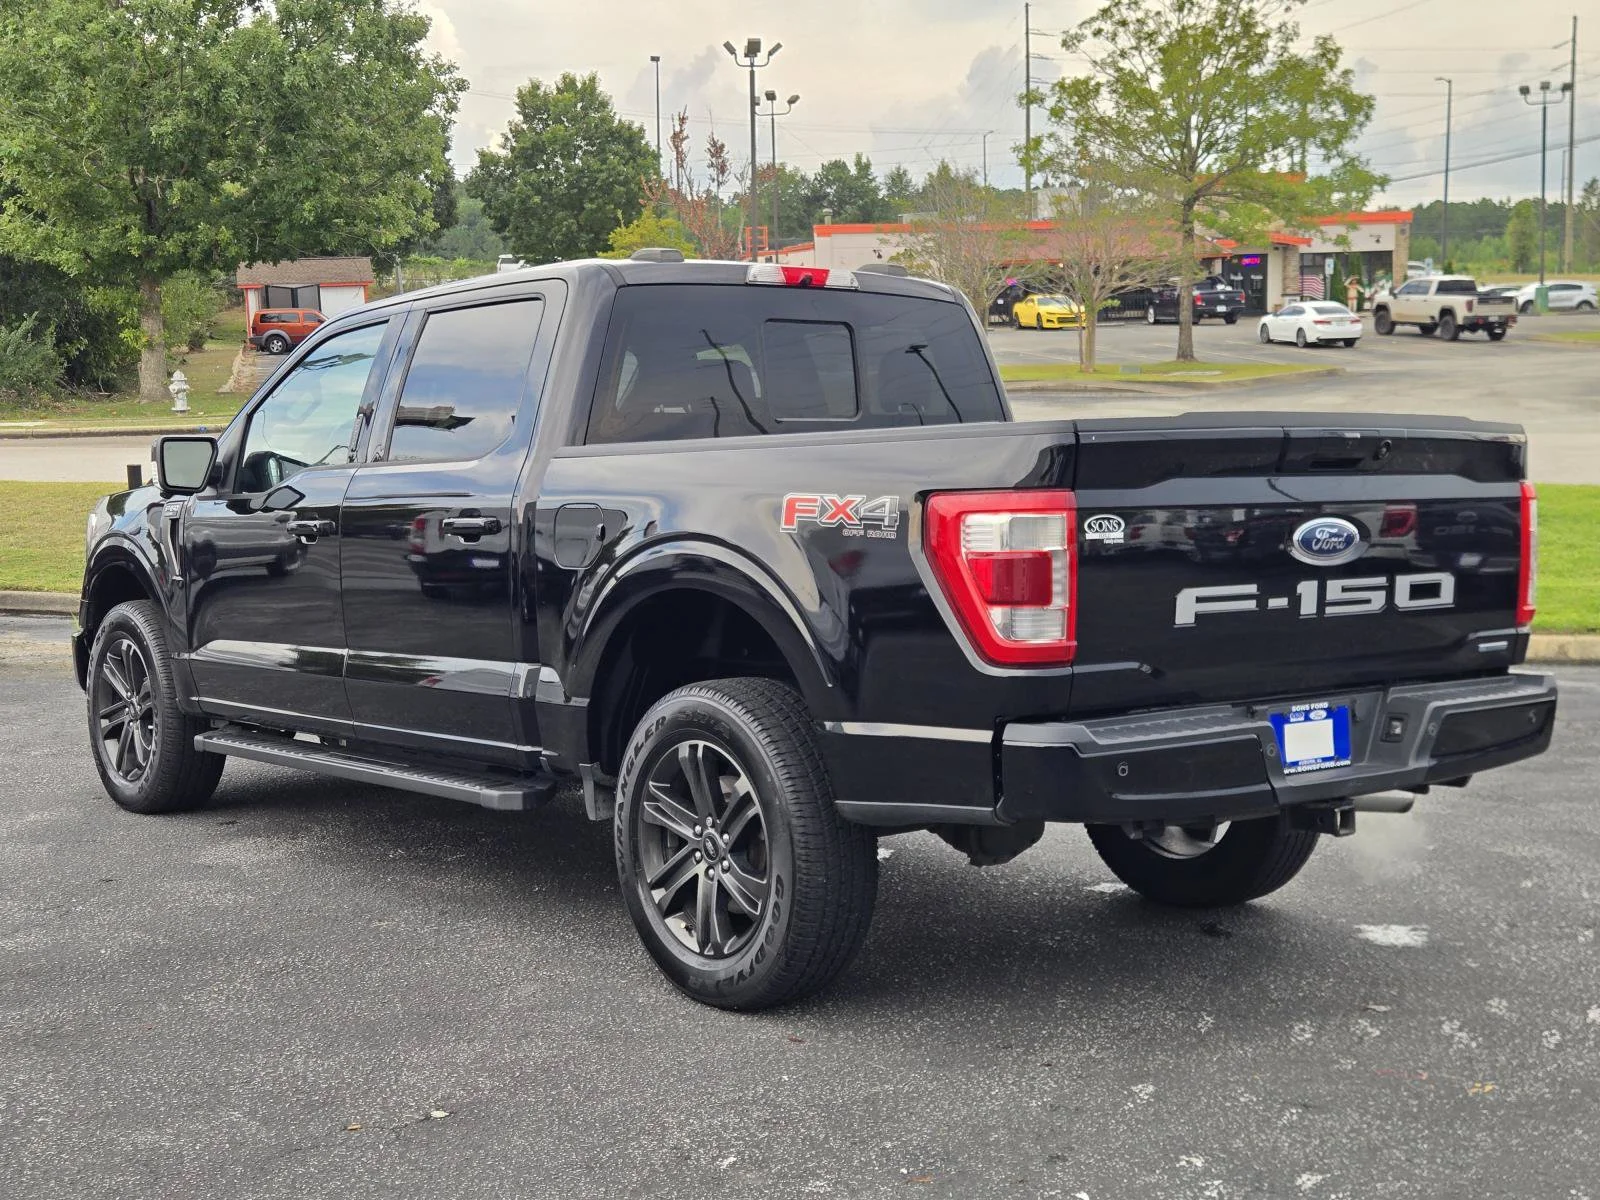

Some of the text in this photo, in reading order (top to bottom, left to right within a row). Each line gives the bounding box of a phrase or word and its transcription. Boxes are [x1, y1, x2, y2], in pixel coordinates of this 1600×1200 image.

[780, 493, 899, 533] FX4
[1090, 519, 1119, 532] SONS
[842, 528, 864, 537] OFF
[1312, 527, 1348, 551] Ford
[1174, 572, 1455, 627] F-150
[615, 715, 668, 877] WRANGLER
